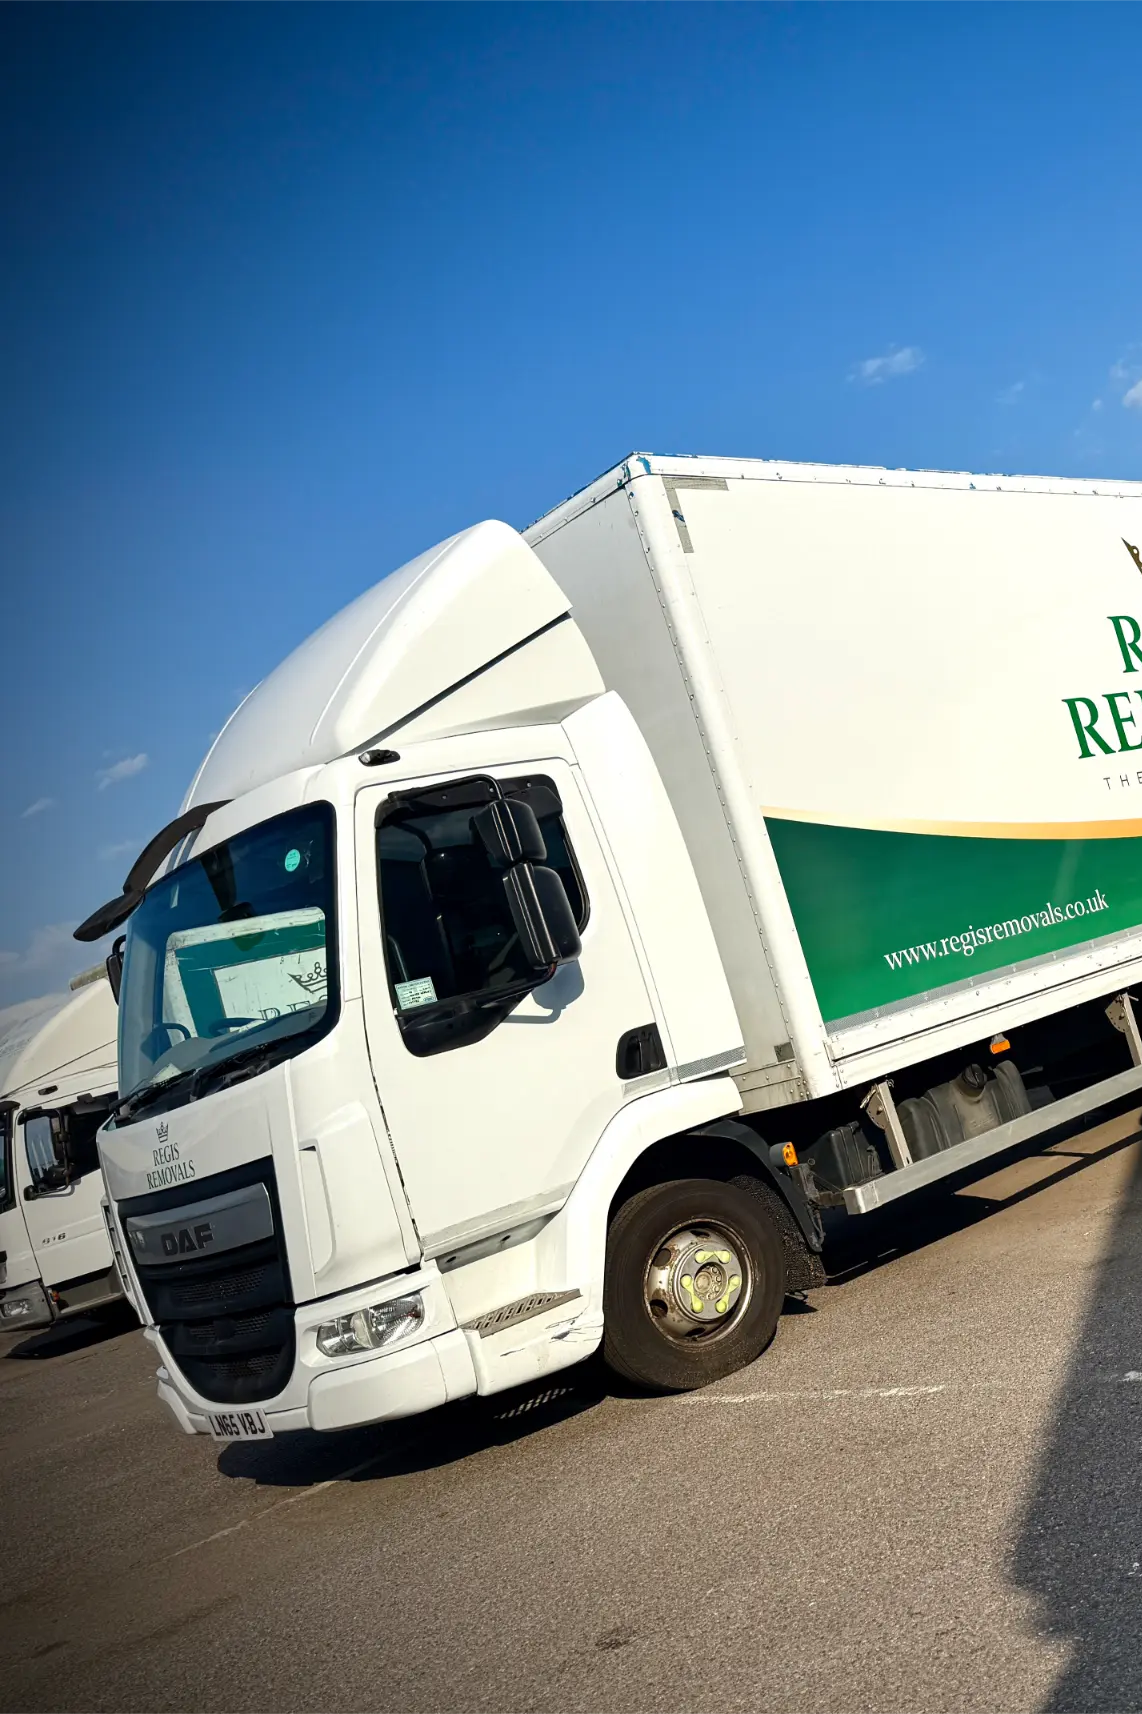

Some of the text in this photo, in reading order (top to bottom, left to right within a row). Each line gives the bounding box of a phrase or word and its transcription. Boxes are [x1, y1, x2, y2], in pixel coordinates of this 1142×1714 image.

[883, 889, 1110, 971] www.regisremovals.co.uk
[152, 1142, 180, 1167] REGIS
[146, 1159, 196, 1190] REMOVALS
[160, 1222, 215, 1256] DAF
[208, 1411, 266, 1436] LN65 VBJ
